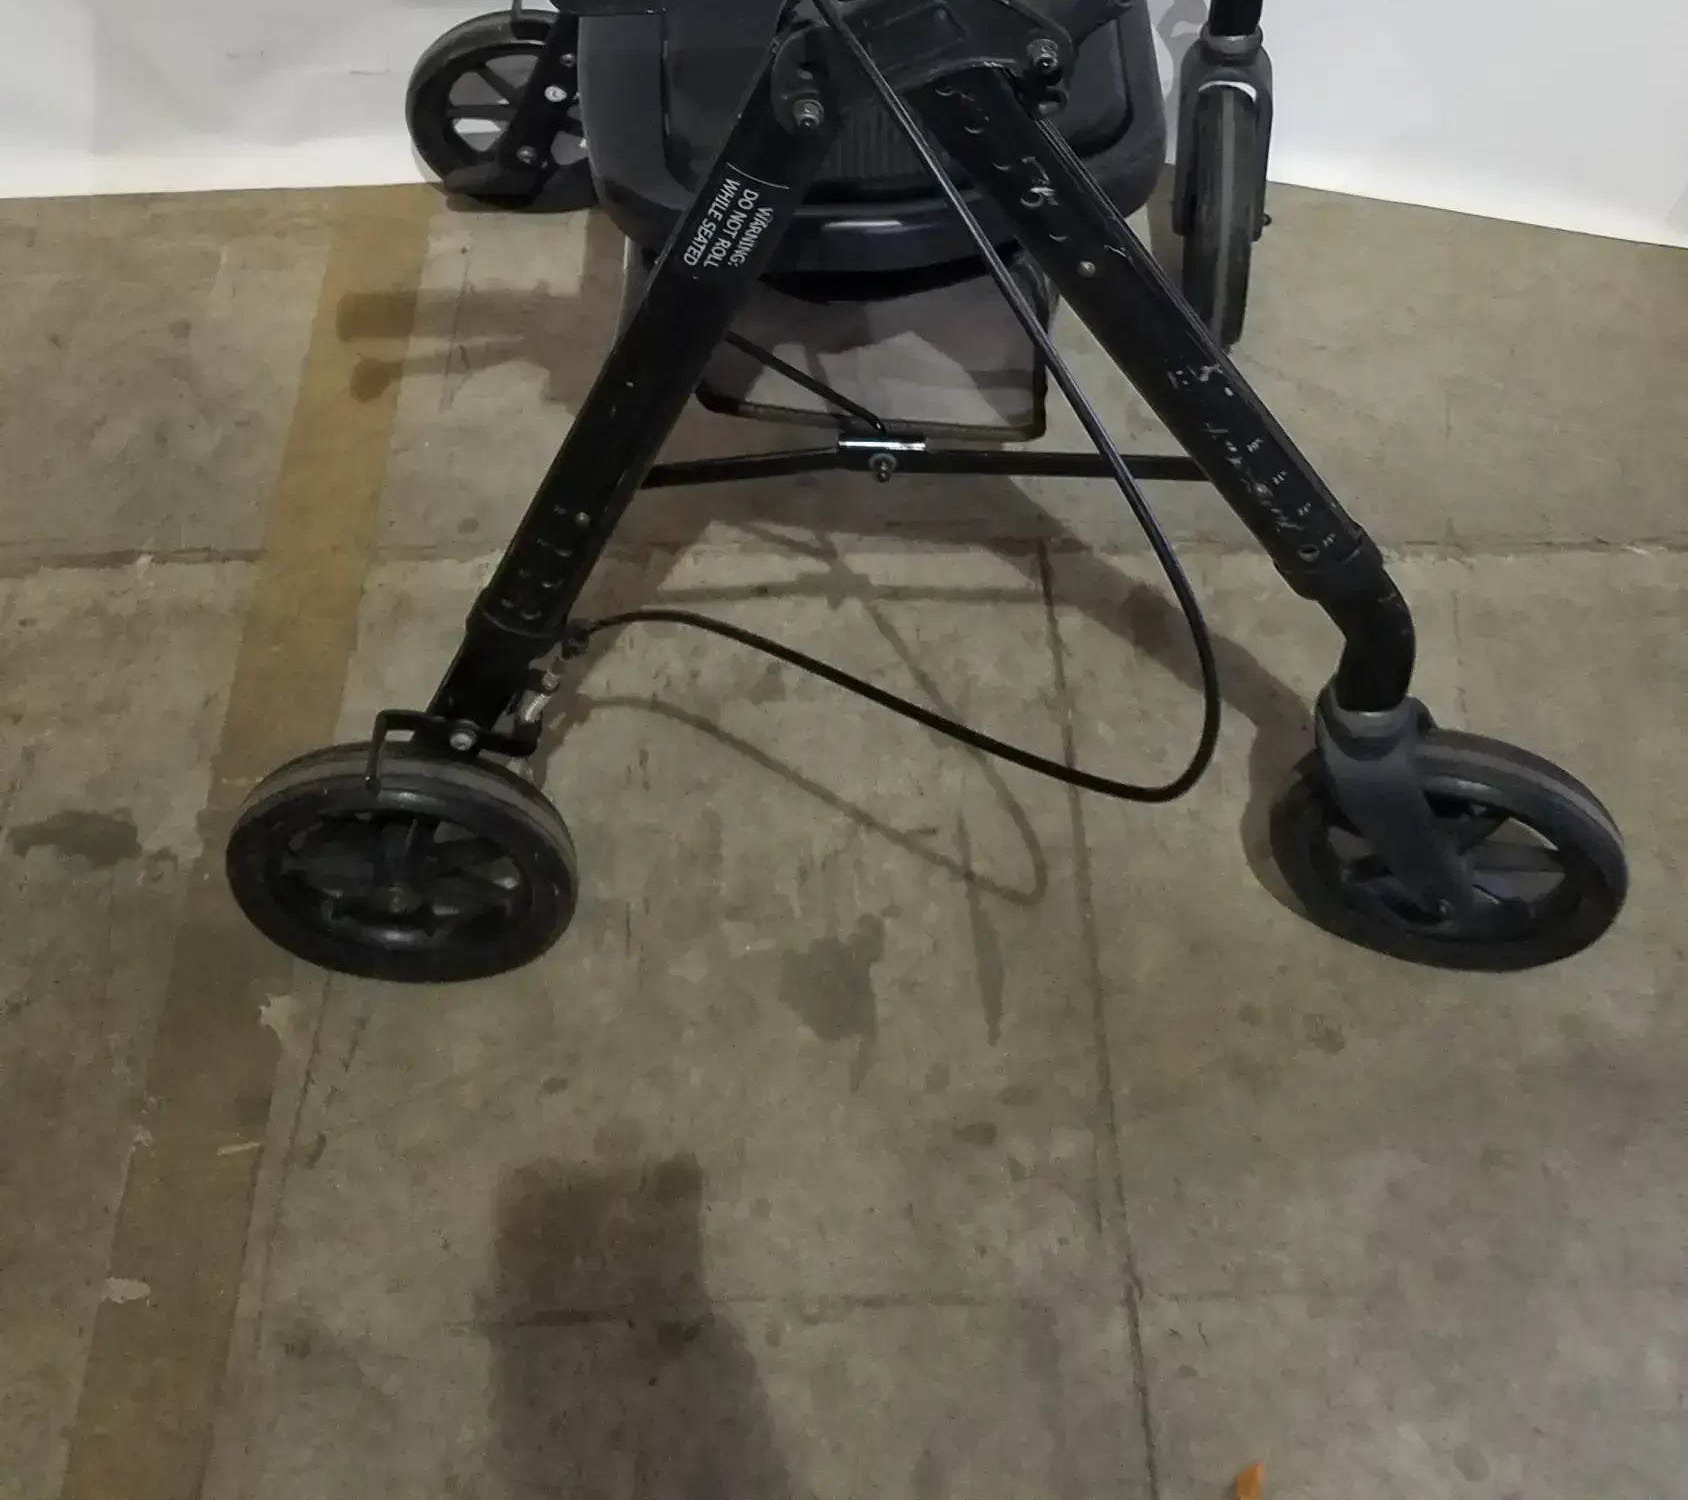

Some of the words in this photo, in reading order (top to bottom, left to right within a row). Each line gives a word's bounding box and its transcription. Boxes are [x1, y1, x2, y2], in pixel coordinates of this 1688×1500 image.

[708, 178, 740, 222] WHILE
[737, 189, 759, 210] DO
[683, 219, 716, 266] SEATED
[723, 210, 747, 239] NOT
[728, 207, 773, 267] WARNING:
[703, 238, 731, 267] ROLL
